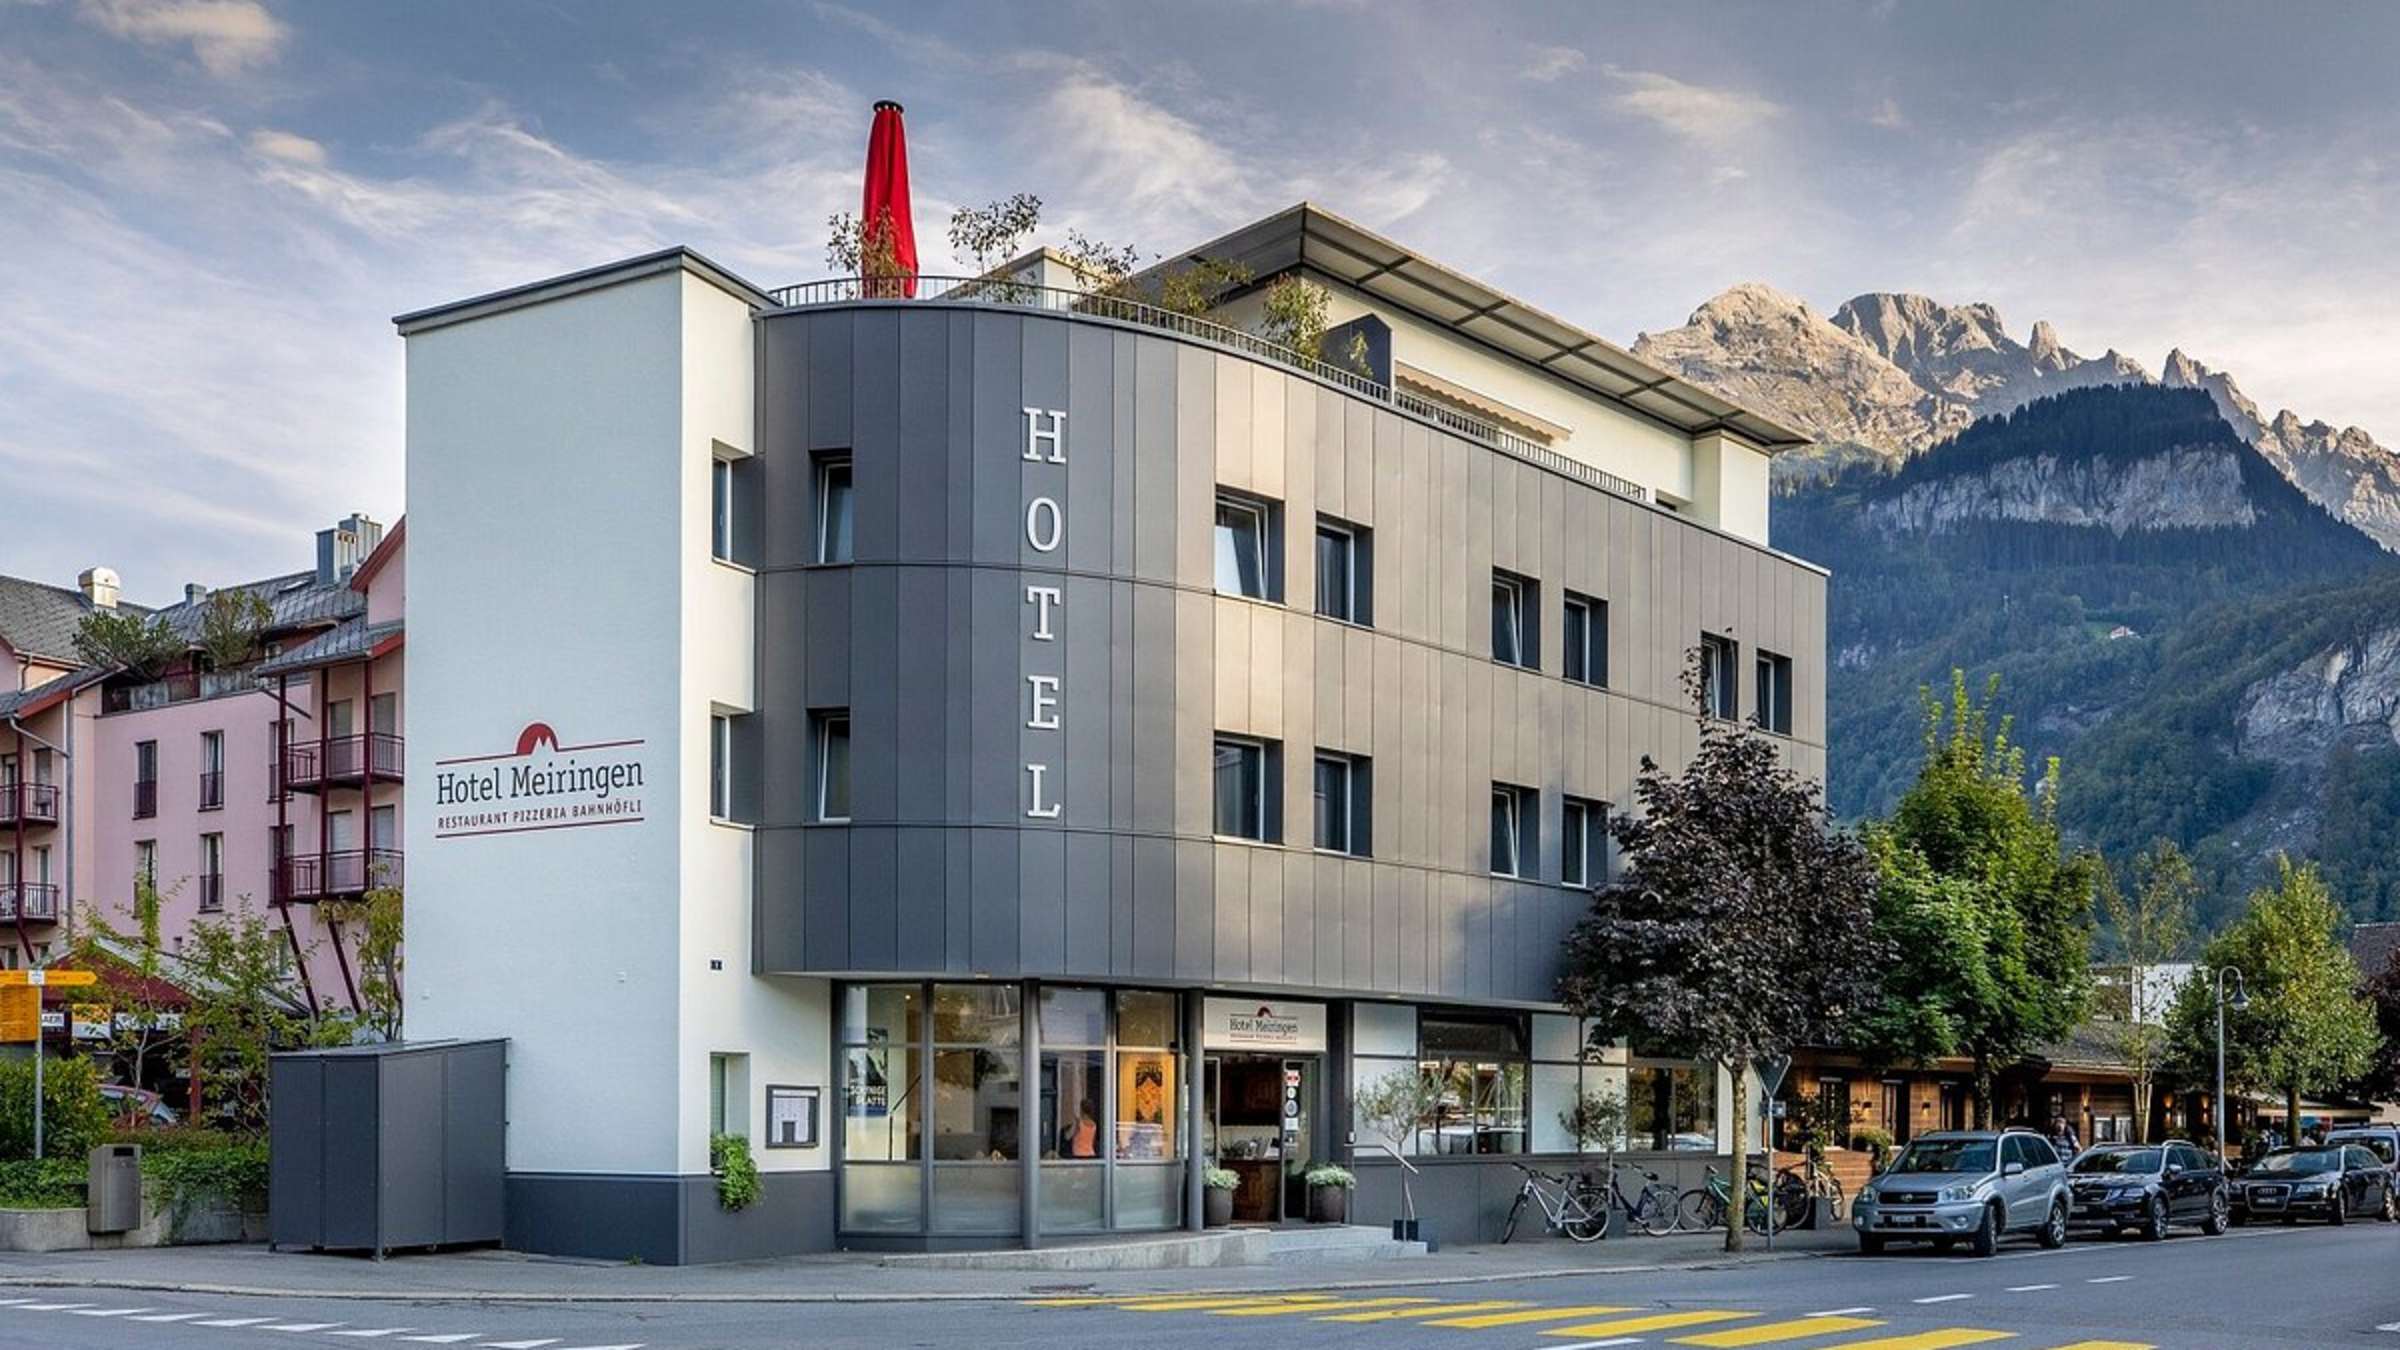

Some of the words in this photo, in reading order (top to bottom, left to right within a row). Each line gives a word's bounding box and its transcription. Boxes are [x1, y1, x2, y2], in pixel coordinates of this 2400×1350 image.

[1022, 406, 1067, 818] HOTEL
[437, 768, 502, 805] Hotel
[511, 759, 643, 798] Meiringen
[438, 812, 508, 828] RESTAURANT
[513, 807, 567, 822] PIZZERIA
[573, 799, 642, 817] BAHNHÖFLI
[1230, 1019, 1254, 1031] Hotel
[1255, 1019, 1298, 1036] Meiringen
